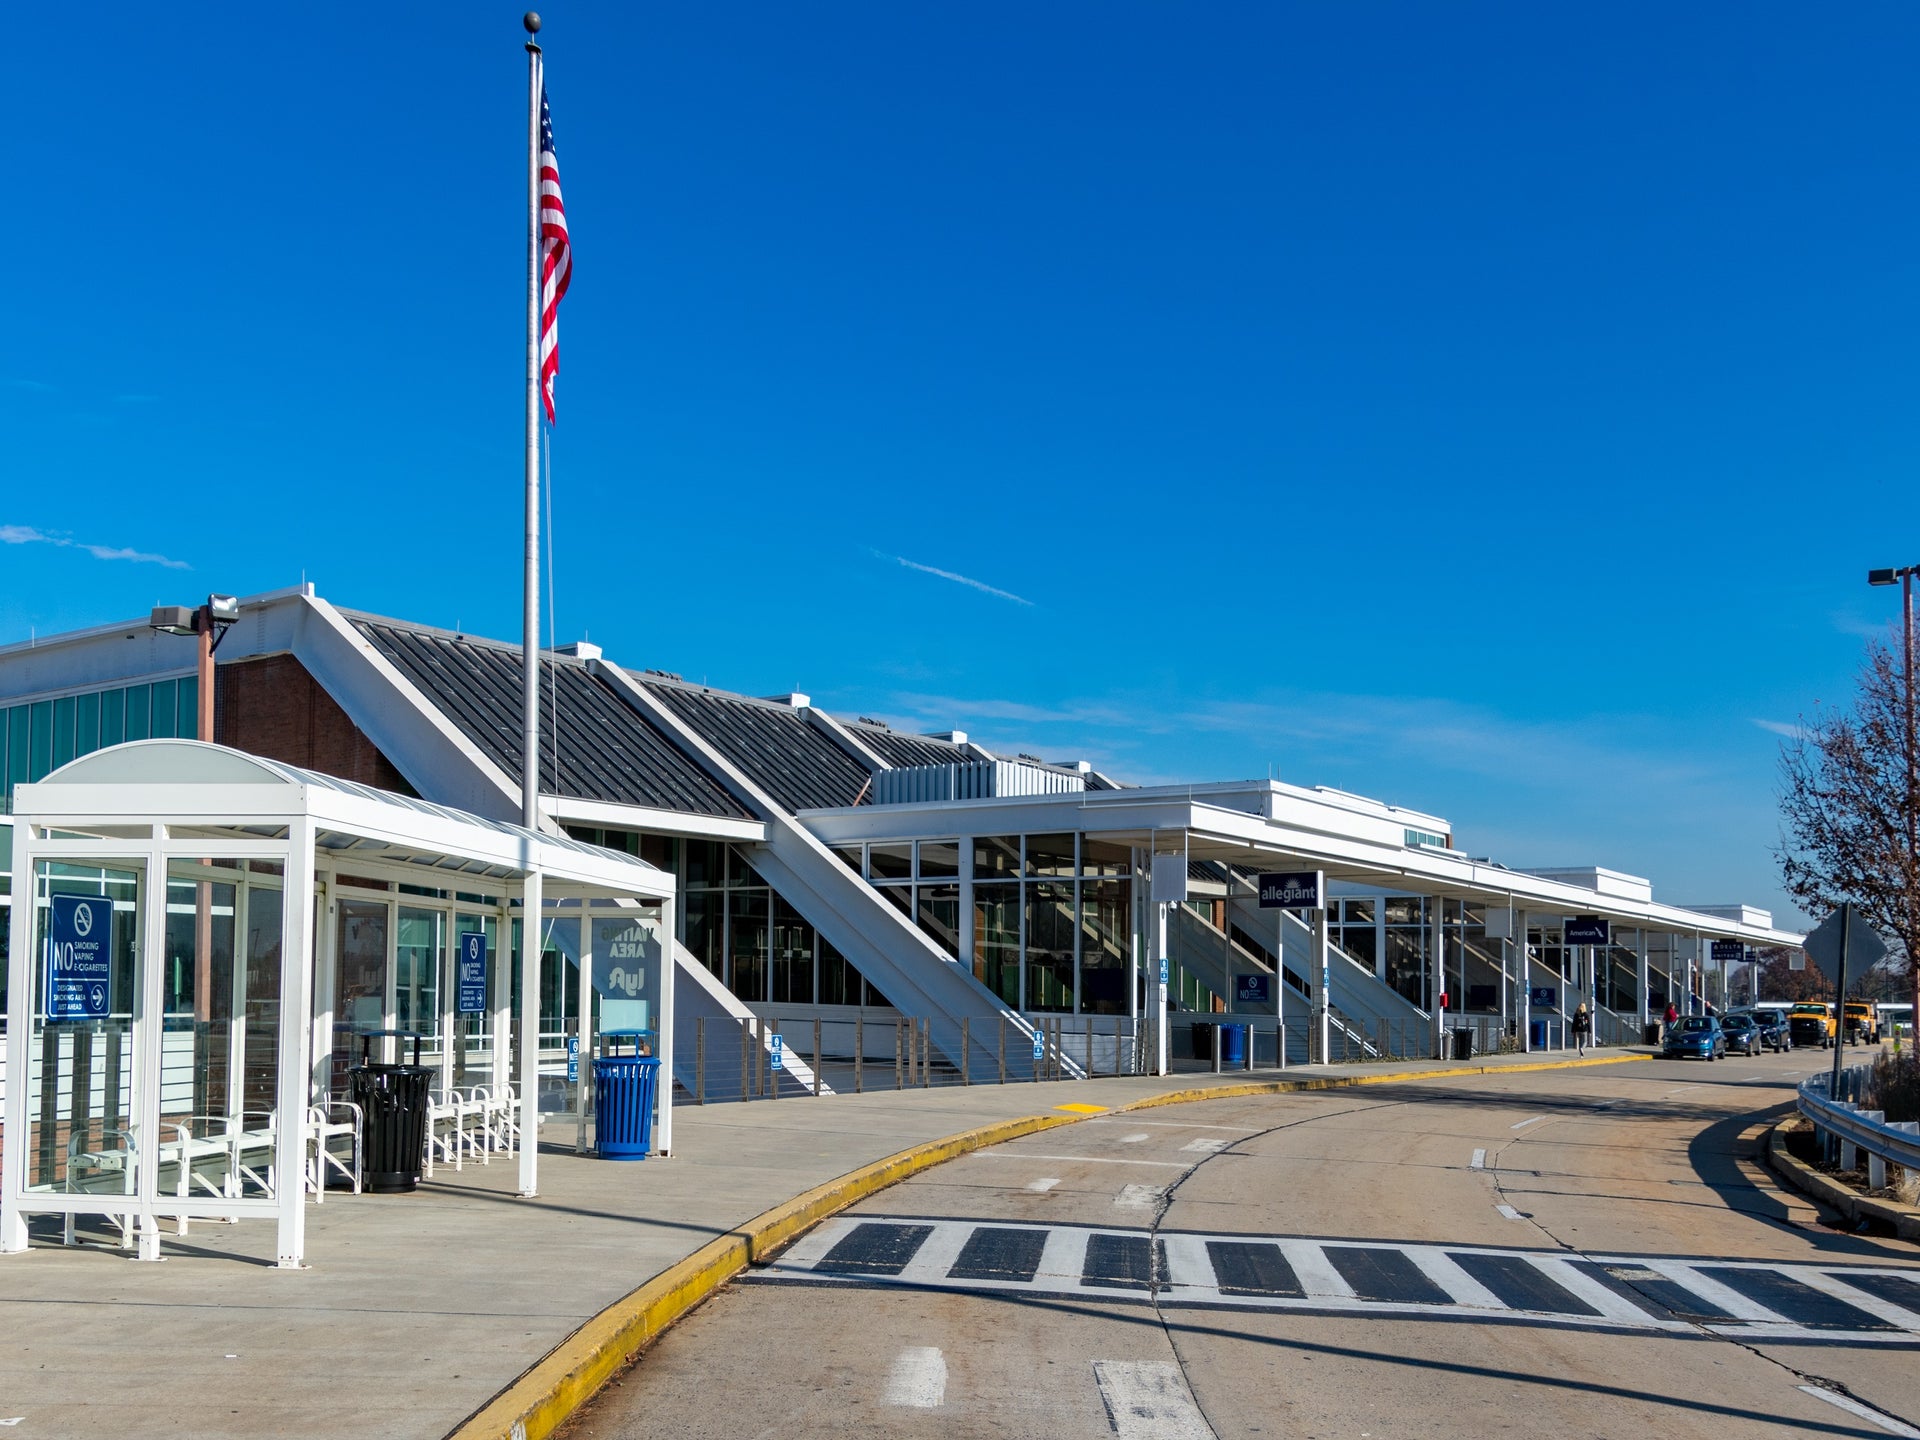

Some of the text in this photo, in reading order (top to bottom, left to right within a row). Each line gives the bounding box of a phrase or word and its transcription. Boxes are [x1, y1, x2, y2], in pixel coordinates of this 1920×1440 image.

[1261, 886, 1316, 903] allegiant
[74, 942, 99, 950] SMOKING
[54, 941, 73, 971] NO
[74, 952, 94, 961] VAPING
[74, 963, 108, 971] E-CIGARETTES
[1240, 989, 1250, 1000] NO
[67, 1003, 83, 1011] AHEAD
